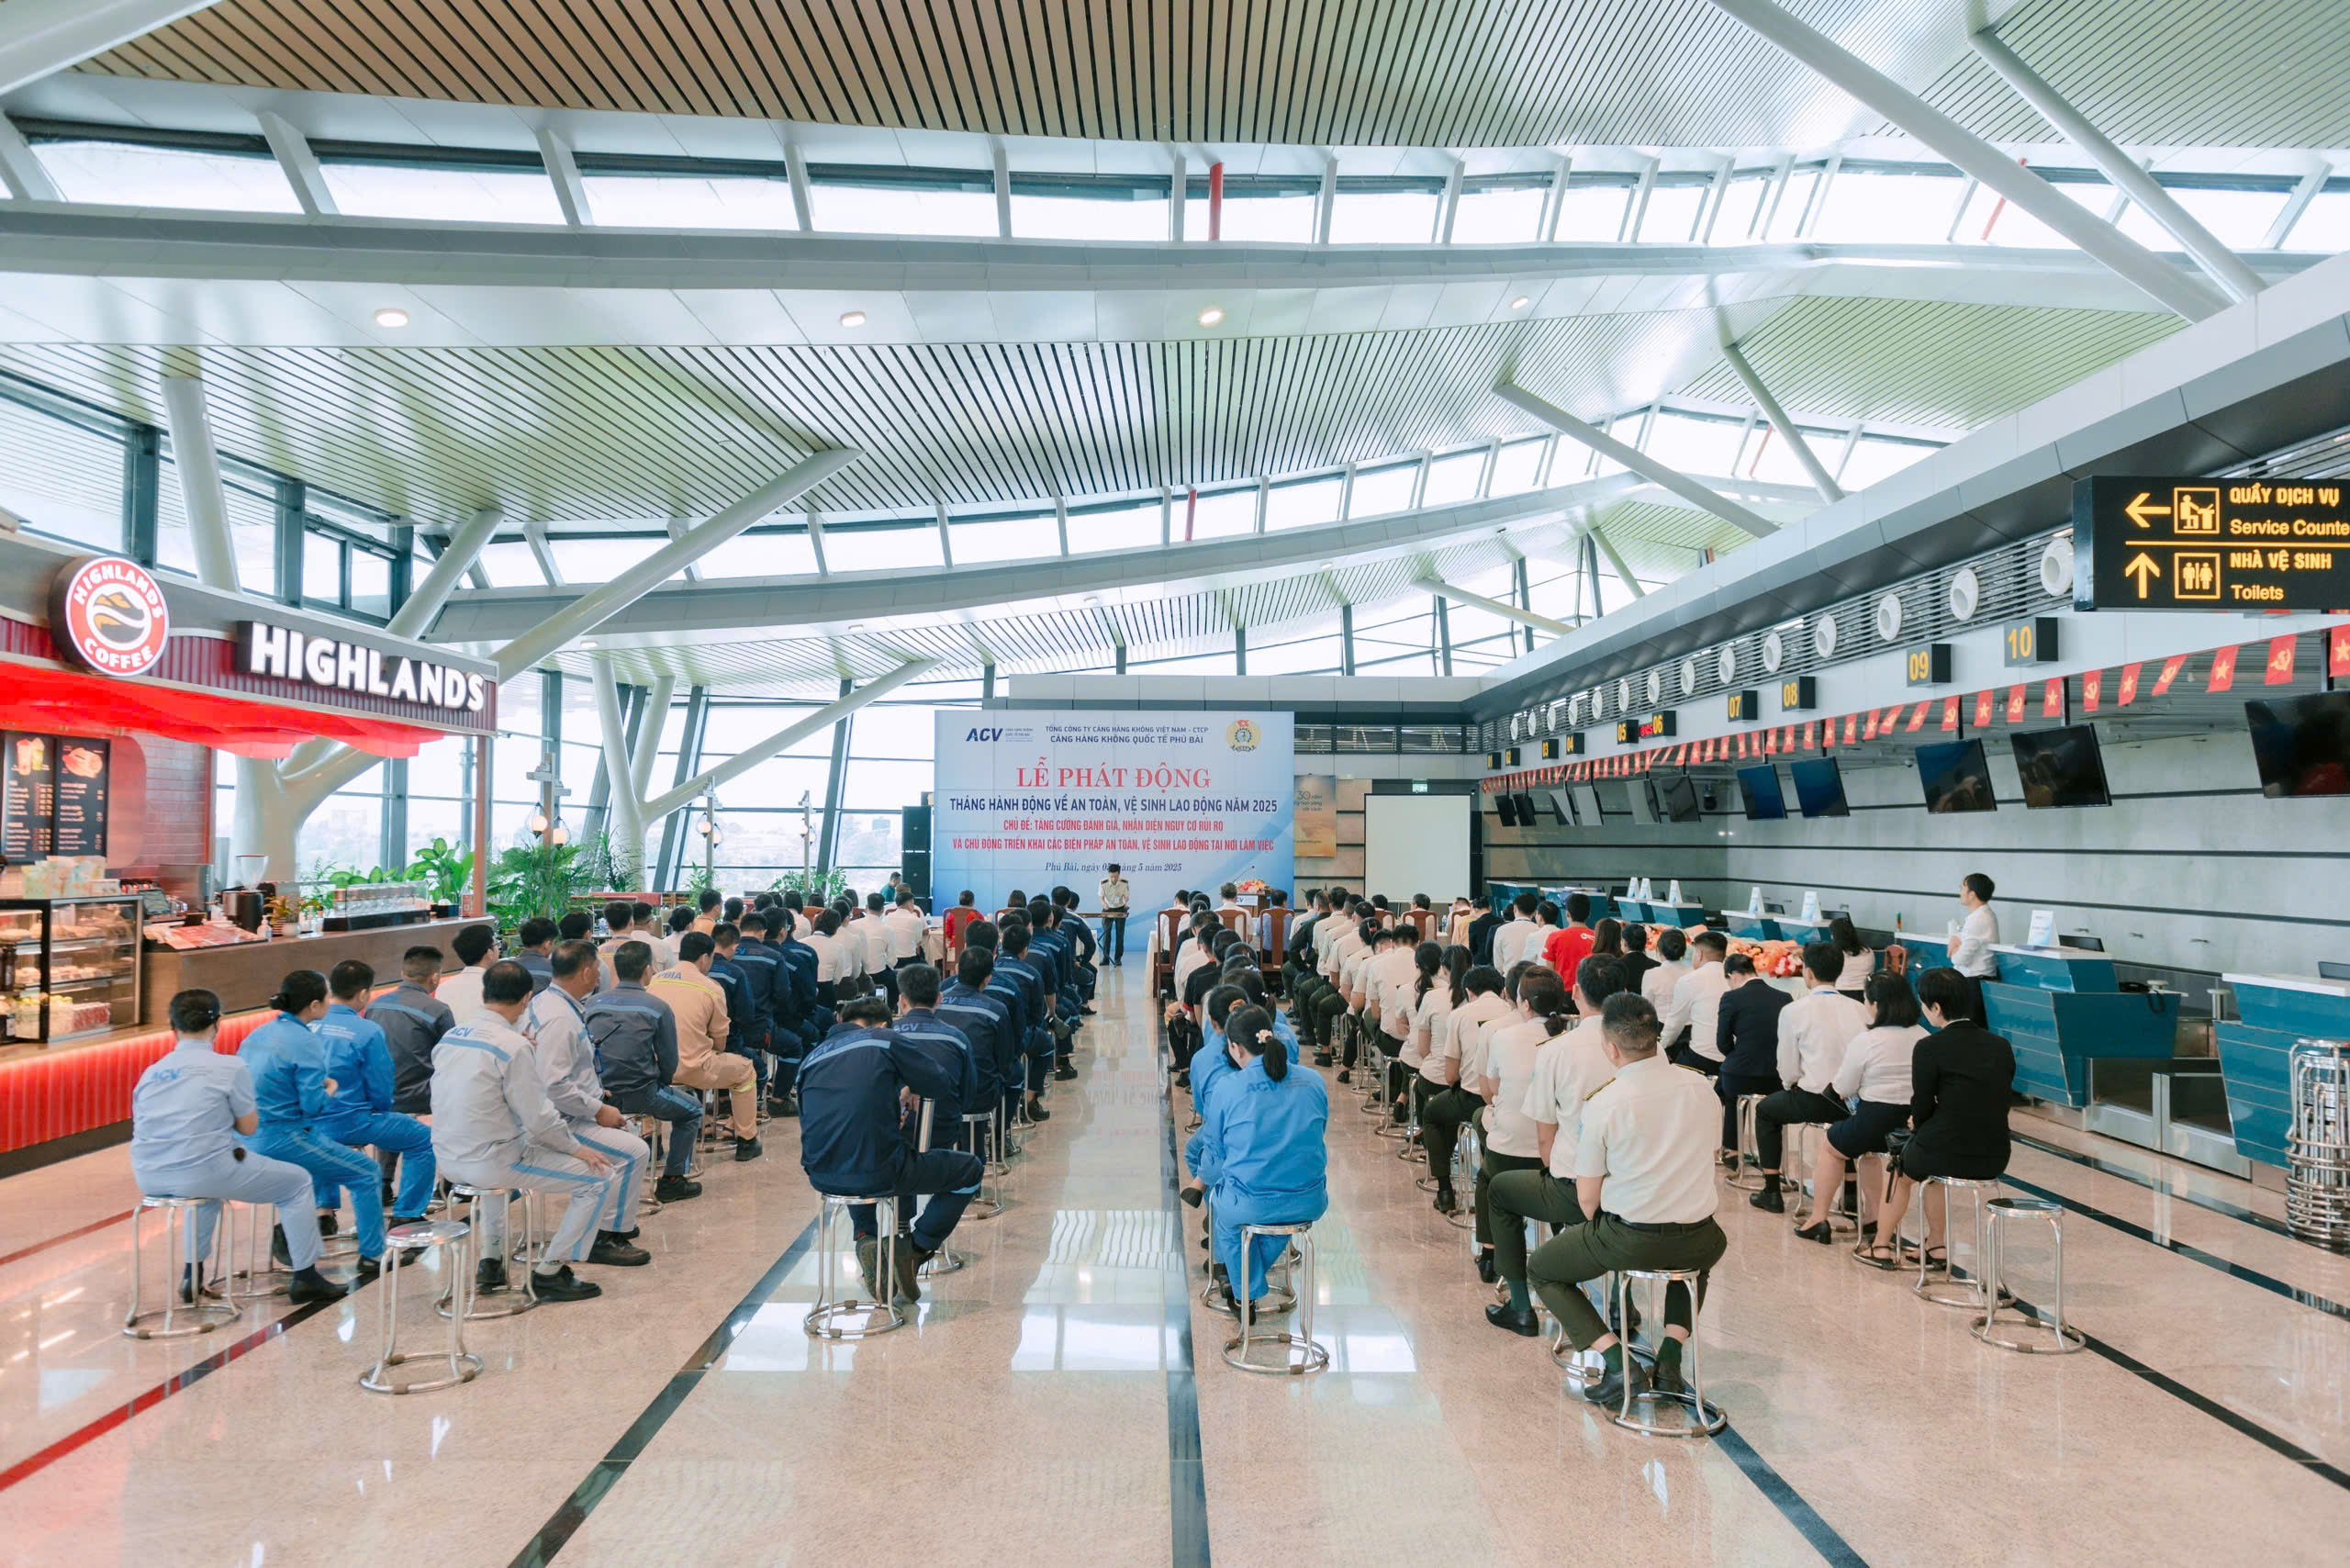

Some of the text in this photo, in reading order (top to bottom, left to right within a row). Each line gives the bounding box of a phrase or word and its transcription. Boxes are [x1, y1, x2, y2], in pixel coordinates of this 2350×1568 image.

[2277, 487, 2313, 507] DỊCH
[2318, 487, 2340, 507] VỤ
[2230, 519, 2289, 535] Service
[2230, 549, 2332, 572] NHÀ VỆ SINH
[73, 565, 163, 619] HIGHLANDS
[2231, 584, 2284, 600] Toilets
[2008, 625, 2032, 660] 10
[84, 637, 153, 669] COFFEE
[251, 622, 485, 712] HIGHLANDS
[1908, 652, 1929, 681] 09
[1783, 682, 1798, 706] 08
[1729, 695, 1741, 718] 07
[1157, 725, 1169, 734] VIỆT
[1617, 722, 1626, 742] 05
[1652, 714, 1662, 734] 06
[966, 728, 1003, 742] ACV
[1075, 734, 1099, 743] HÀNG
[1102, 734, 1131, 743] KHÔNG
[1133, 734, 1155, 745] QUỐC
[1157, 734, 1168, 744] TẾ
[1189, 734, 1203, 744] BÀI
[1566, 735, 1573, 752] 04
[1542, 741, 1549, 757] 03
[1016, 756, 1212, 793] LỄ PHÁT ĐỘNG
[950, 793, 1278, 815] THÁNG HÀNH ĐỘNG VỀ AN TOÀN, VỆ SINH LAO ĐỘNG NĂM 2025
[1297, 791, 1311, 801] 30
[1123, 817, 1144, 834] NHẬN
[1165, 821, 1184, 832] NGUY
[1187, 820, 1197, 832] CƠ
[1214, 821, 1224, 832] RO
[982, 835, 1002, 852] ĐỘNG
[1028, 839, 1045, 850] KHAI
[1046, 836, 1062, 850] CÁC
[1065, 836, 1081, 852] BIỆN
[1083, 836, 1103, 850] PHÁP
[1105, 839, 1116, 850] AN
[1118, 836, 1140, 852] TOÀN,
[1153, 839, 1170, 850] SINH
[1173, 839, 1186, 850] LAO
[1189, 837, 1209, 852] ĐỘNG
[1212, 839, 1223, 852] TẠI
[1239, 837, 1255, 850] LÀM
[1258, 837, 1274, 853] VIỆC
[1081, 863, 1102, 873] ngày
[1138, 863, 1144, 872] 5
[1164, 863, 1182, 872] 2025
